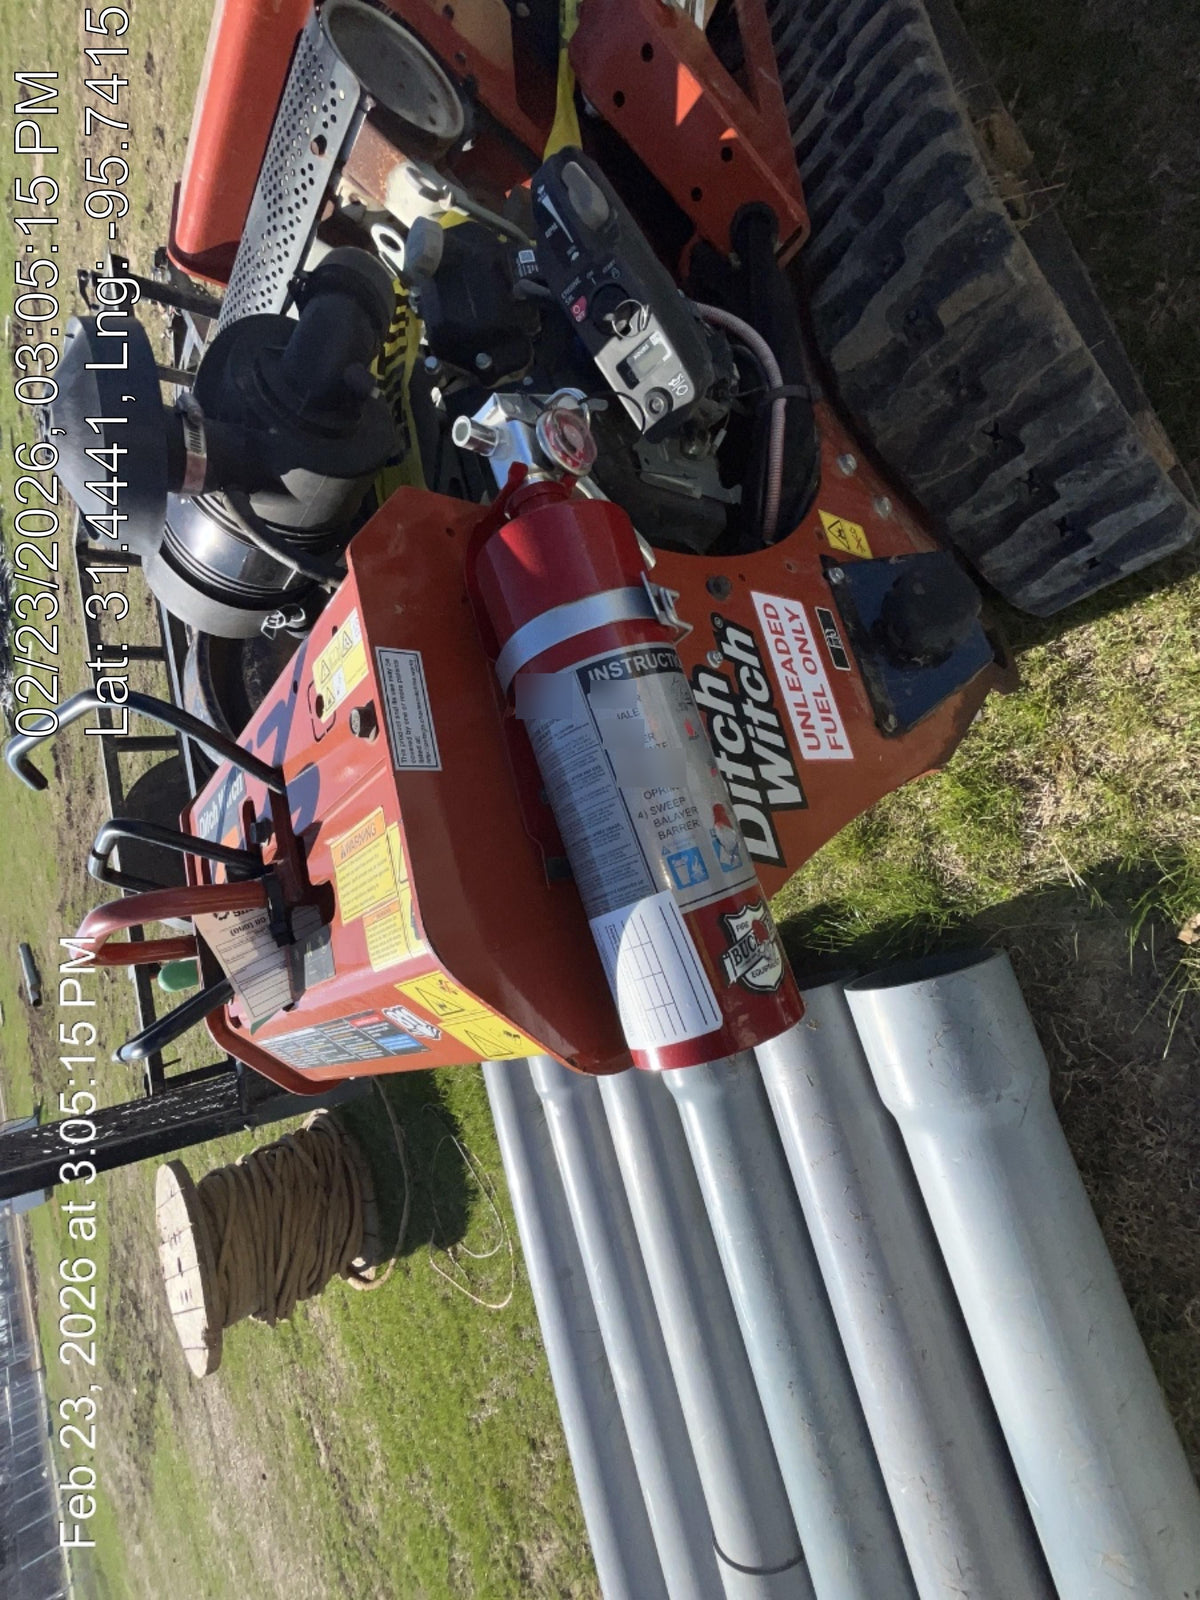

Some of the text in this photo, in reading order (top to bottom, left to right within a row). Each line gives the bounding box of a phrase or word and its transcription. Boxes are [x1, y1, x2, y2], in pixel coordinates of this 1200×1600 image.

[720, 626, 803, 804] Witch
[762, 602, 822, 750] UNLEADED
[783, 606, 845, 750] FUEL ONLY
[649, 796, 686, 816] SWEEP
[652, 806, 698, 828] BALAYER
[658, 819, 700, 840] BARRER
[691, 671, 780, 859] Ditch
